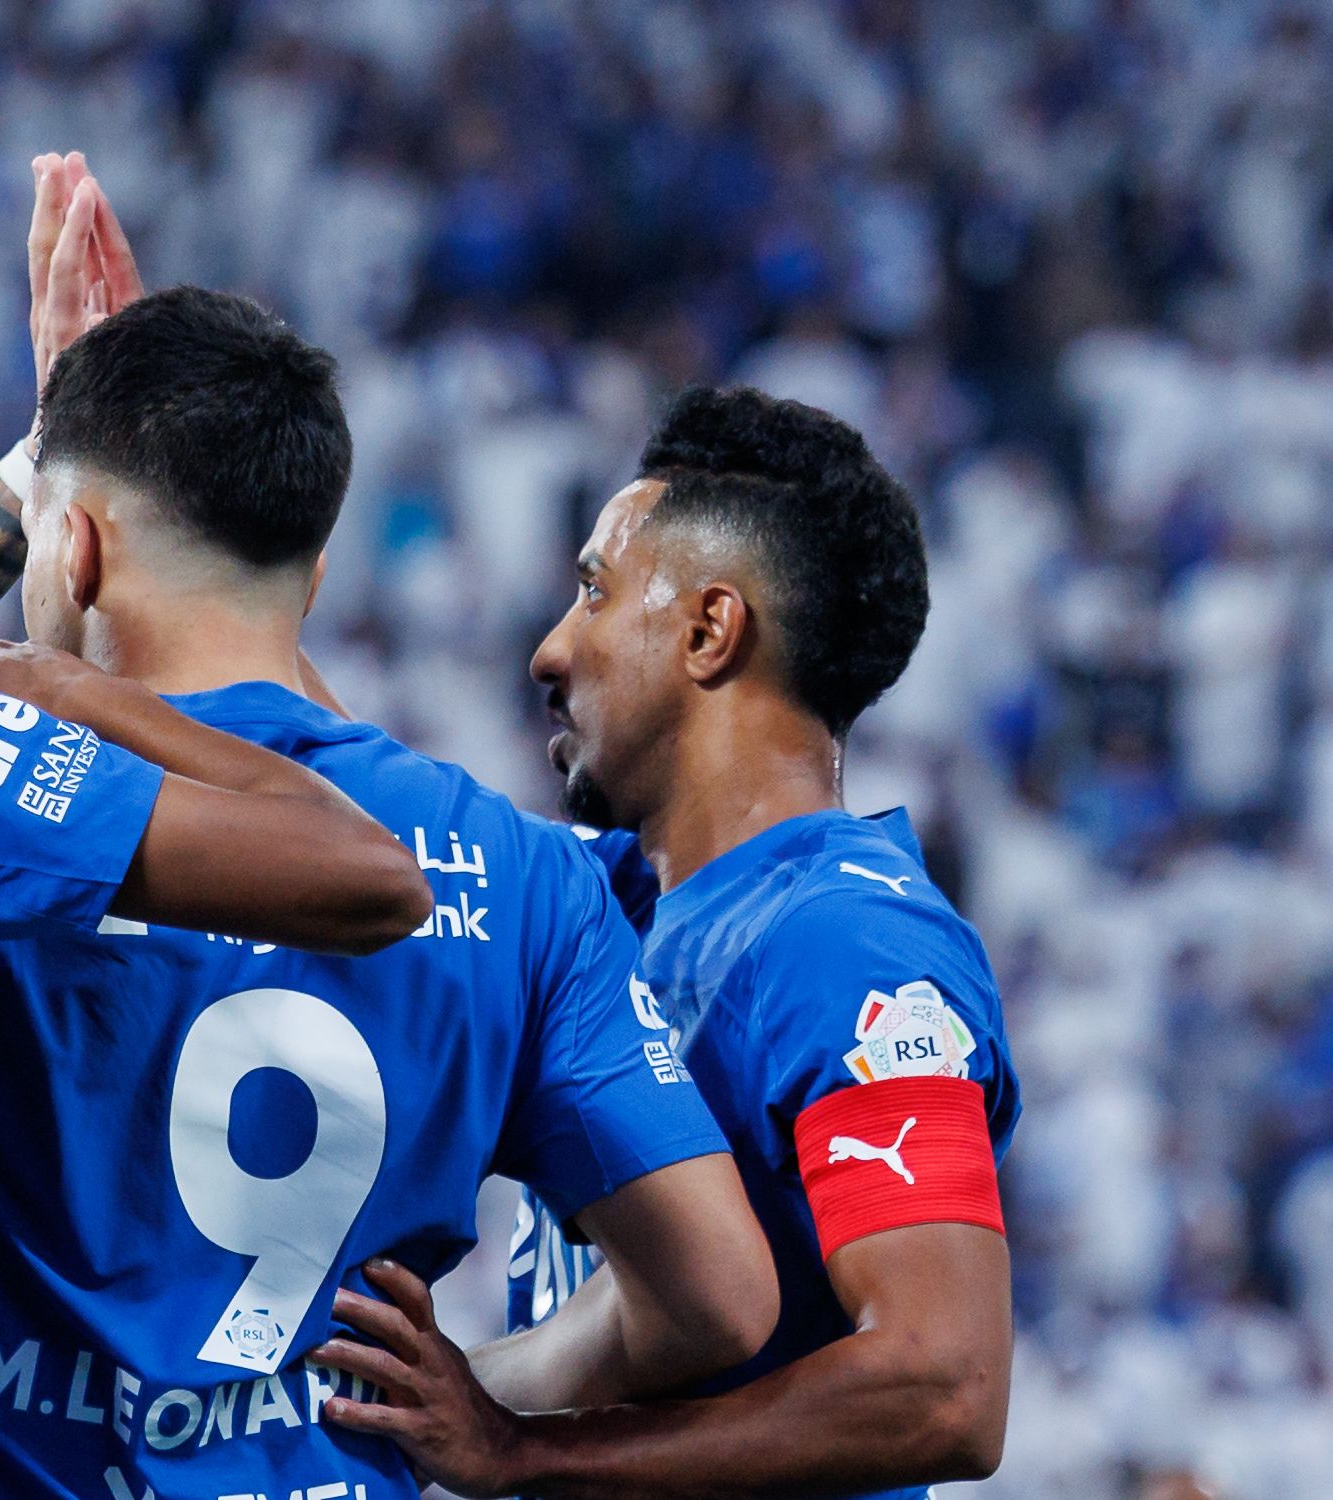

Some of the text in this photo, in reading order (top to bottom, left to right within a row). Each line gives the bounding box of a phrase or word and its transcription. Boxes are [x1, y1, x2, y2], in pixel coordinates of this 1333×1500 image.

[32, 720, 85, 788] SAN
[59, 729, 101, 794] INVEST
[894, 1036, 941, 1062] RSL
[169, 987, 387, 1375] 9
[243, 1328, 266, 1341] RSL
